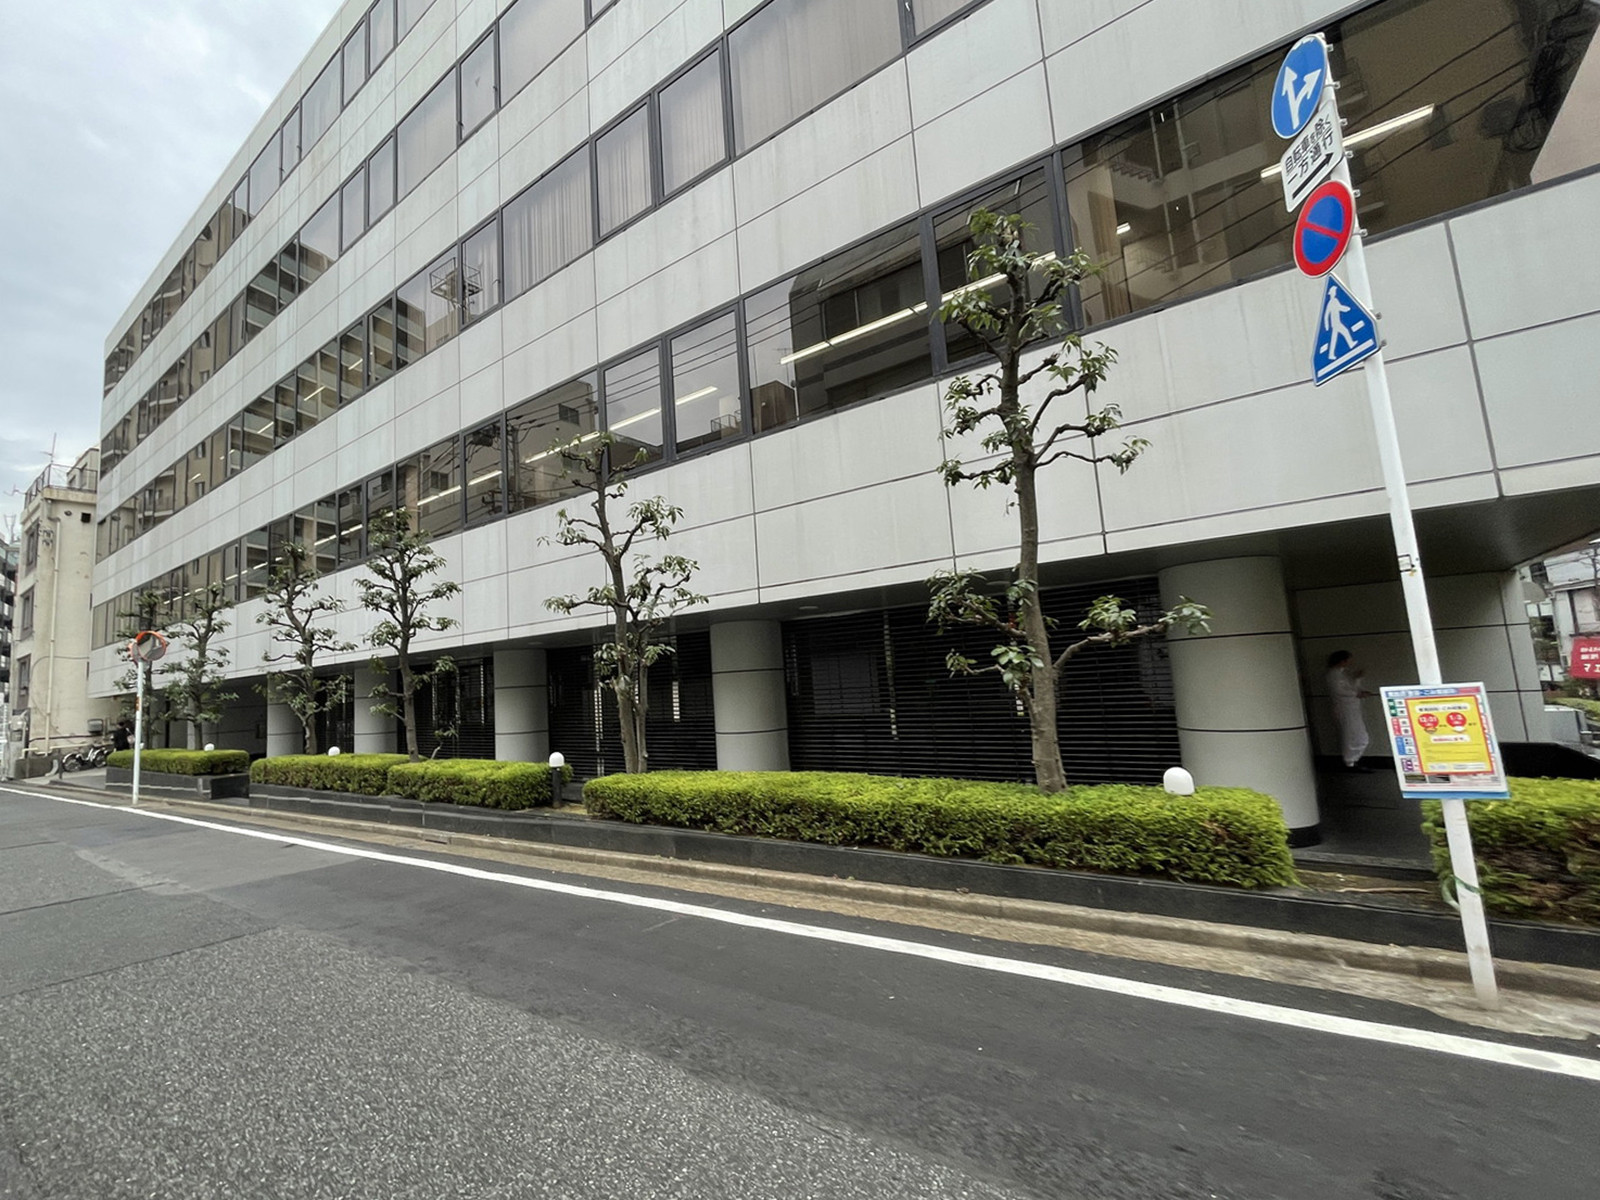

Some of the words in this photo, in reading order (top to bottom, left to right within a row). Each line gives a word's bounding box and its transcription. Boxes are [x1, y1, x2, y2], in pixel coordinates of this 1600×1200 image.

[1285, 114, 1332, 175] 自転車を除く
[1288, 127, 1333, 184] 一方通行
